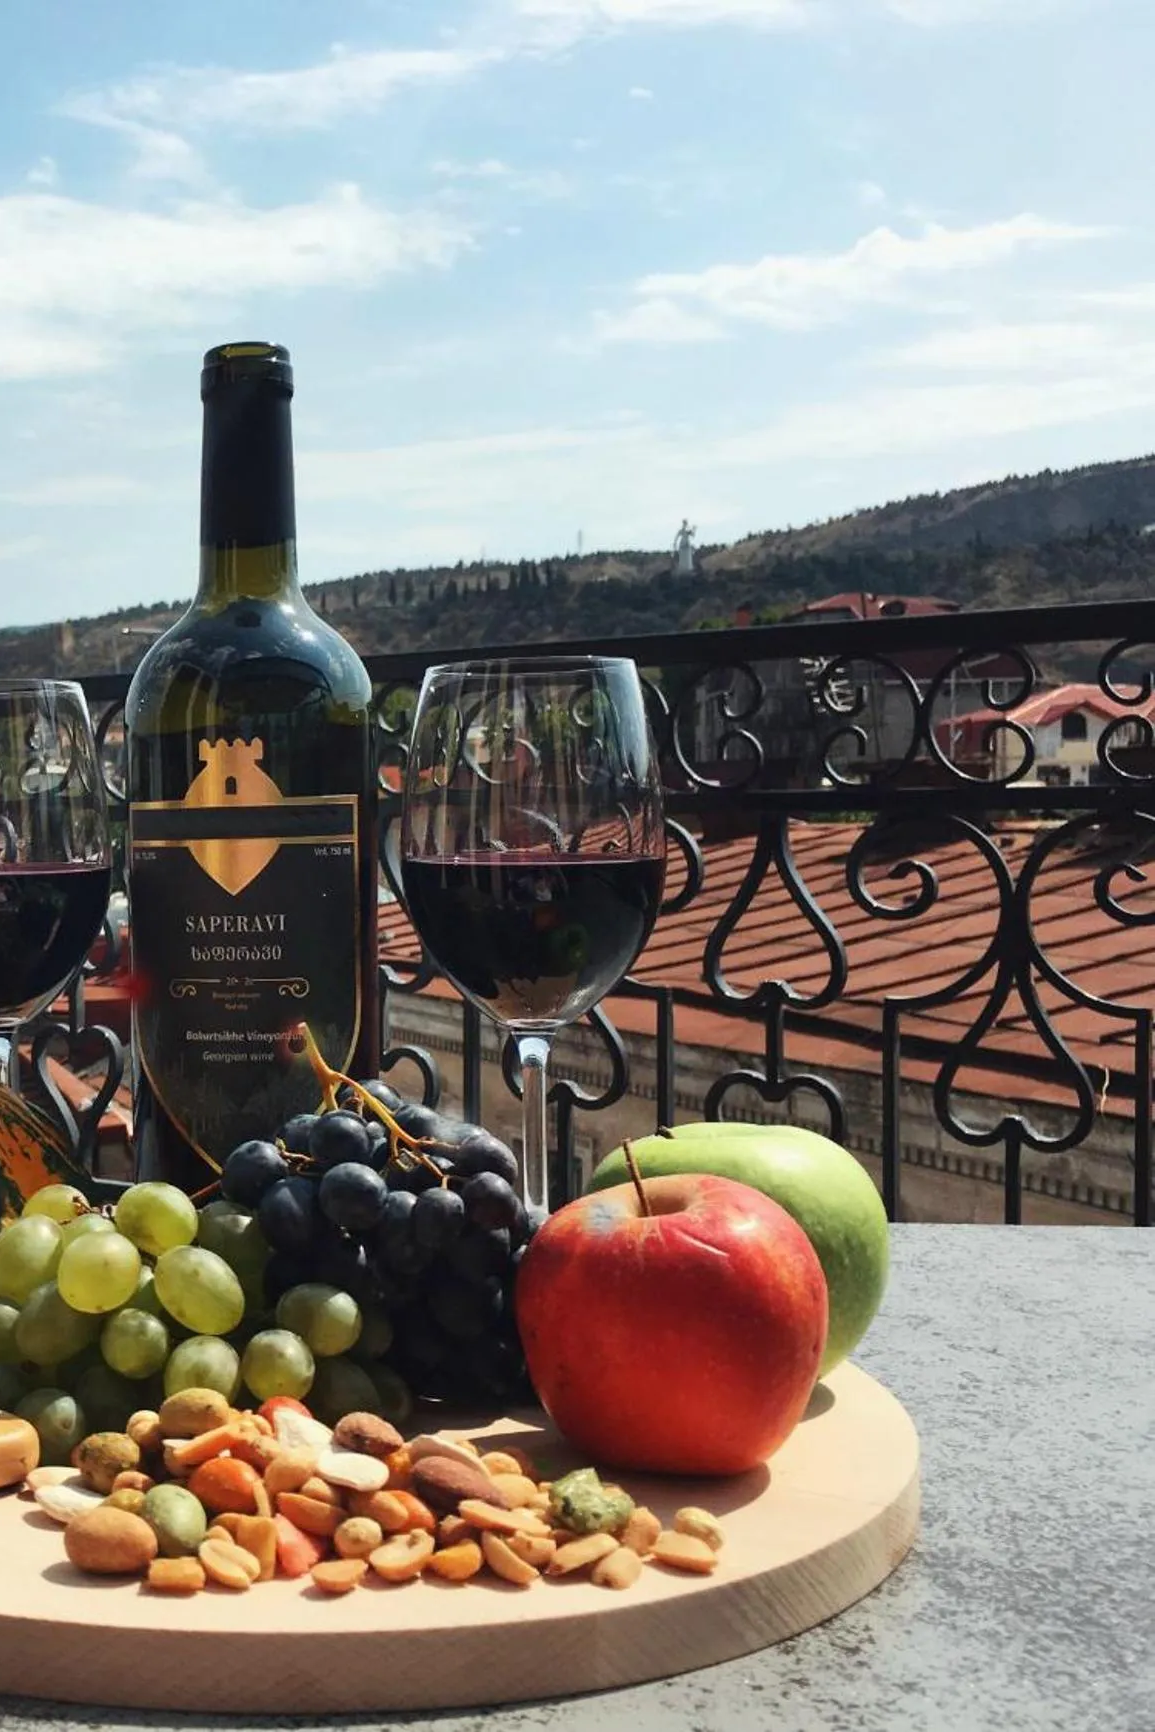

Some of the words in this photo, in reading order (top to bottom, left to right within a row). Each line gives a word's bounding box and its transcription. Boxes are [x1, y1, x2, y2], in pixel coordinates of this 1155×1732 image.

[185, 914, 286, 933] SAPERAVI
[191, 945, 282, 961] საფერავი
[203, 1051, 247, 1063] Georgian
[250, 1051, 274, 1061] wine
